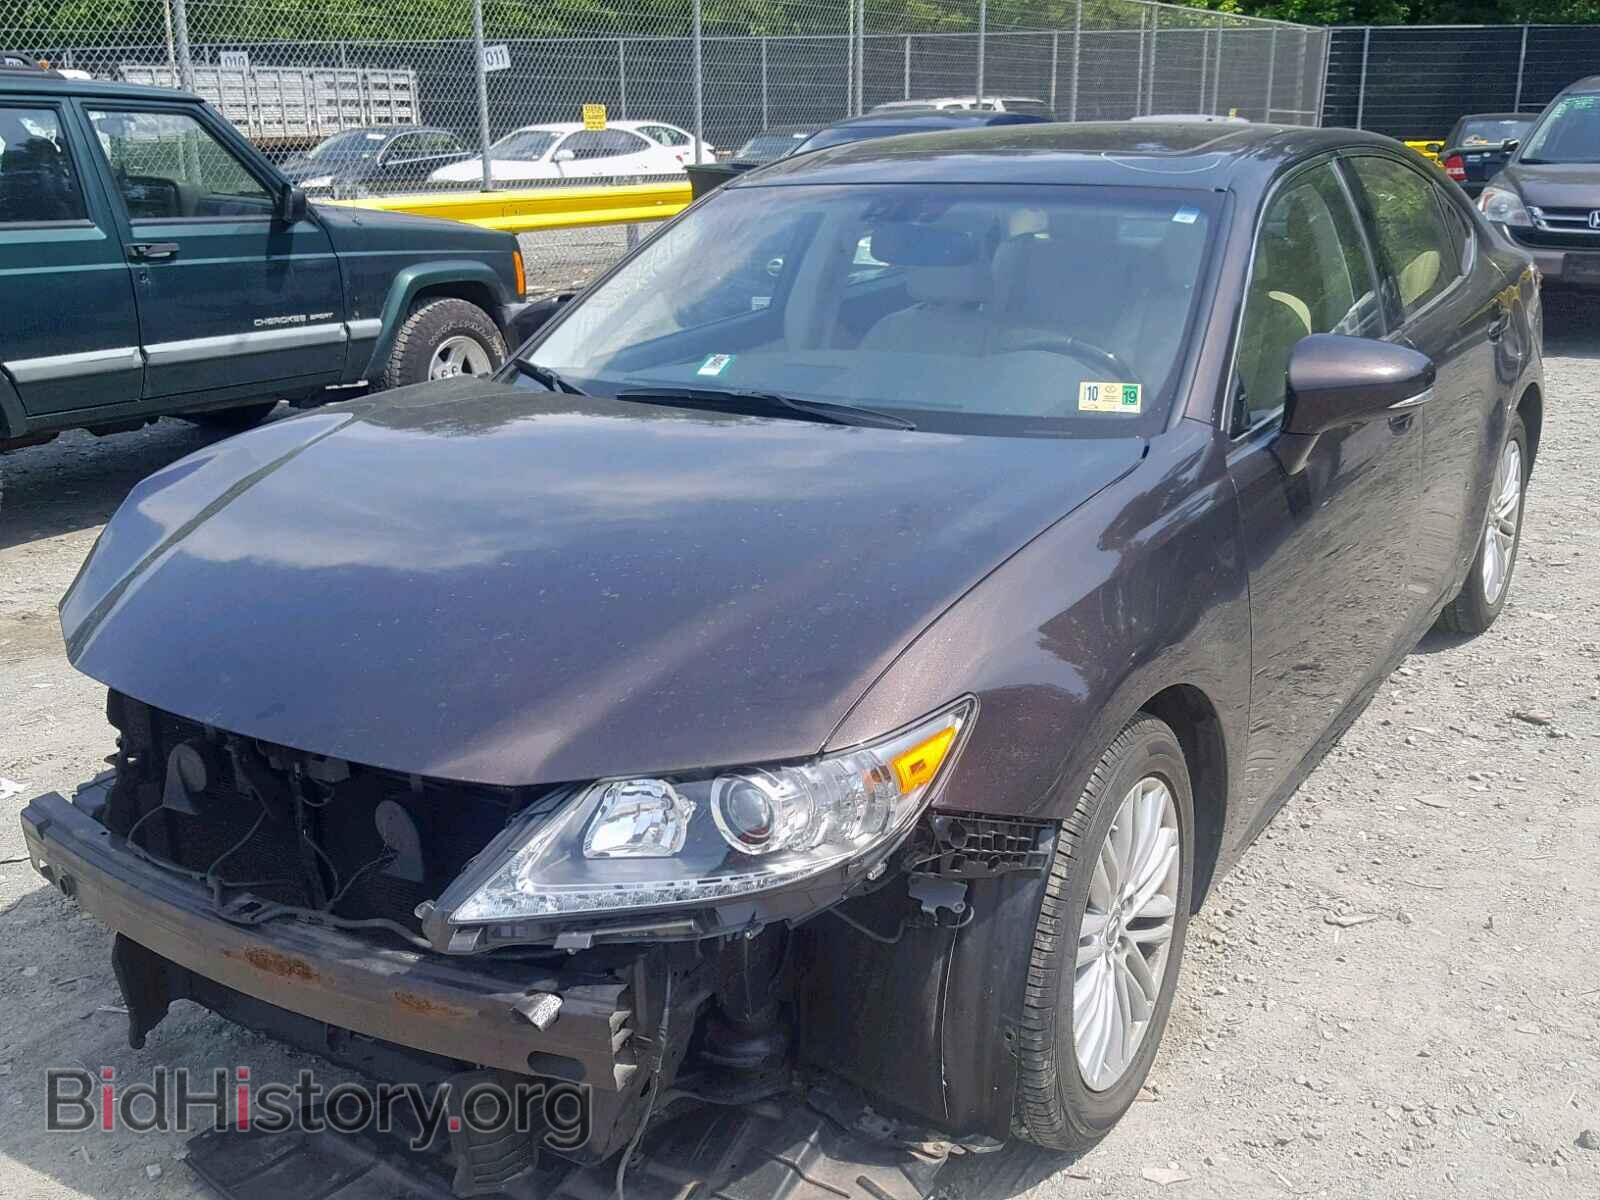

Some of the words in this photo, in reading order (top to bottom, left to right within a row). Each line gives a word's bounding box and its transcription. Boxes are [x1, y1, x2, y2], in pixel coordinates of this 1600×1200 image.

[485, 49, 506, 66] 011
[254, 314, 307, 327] CHEROKEE
[1087, 385, 1099, 401] 10
[1122, 390, 1137, 404] 19
